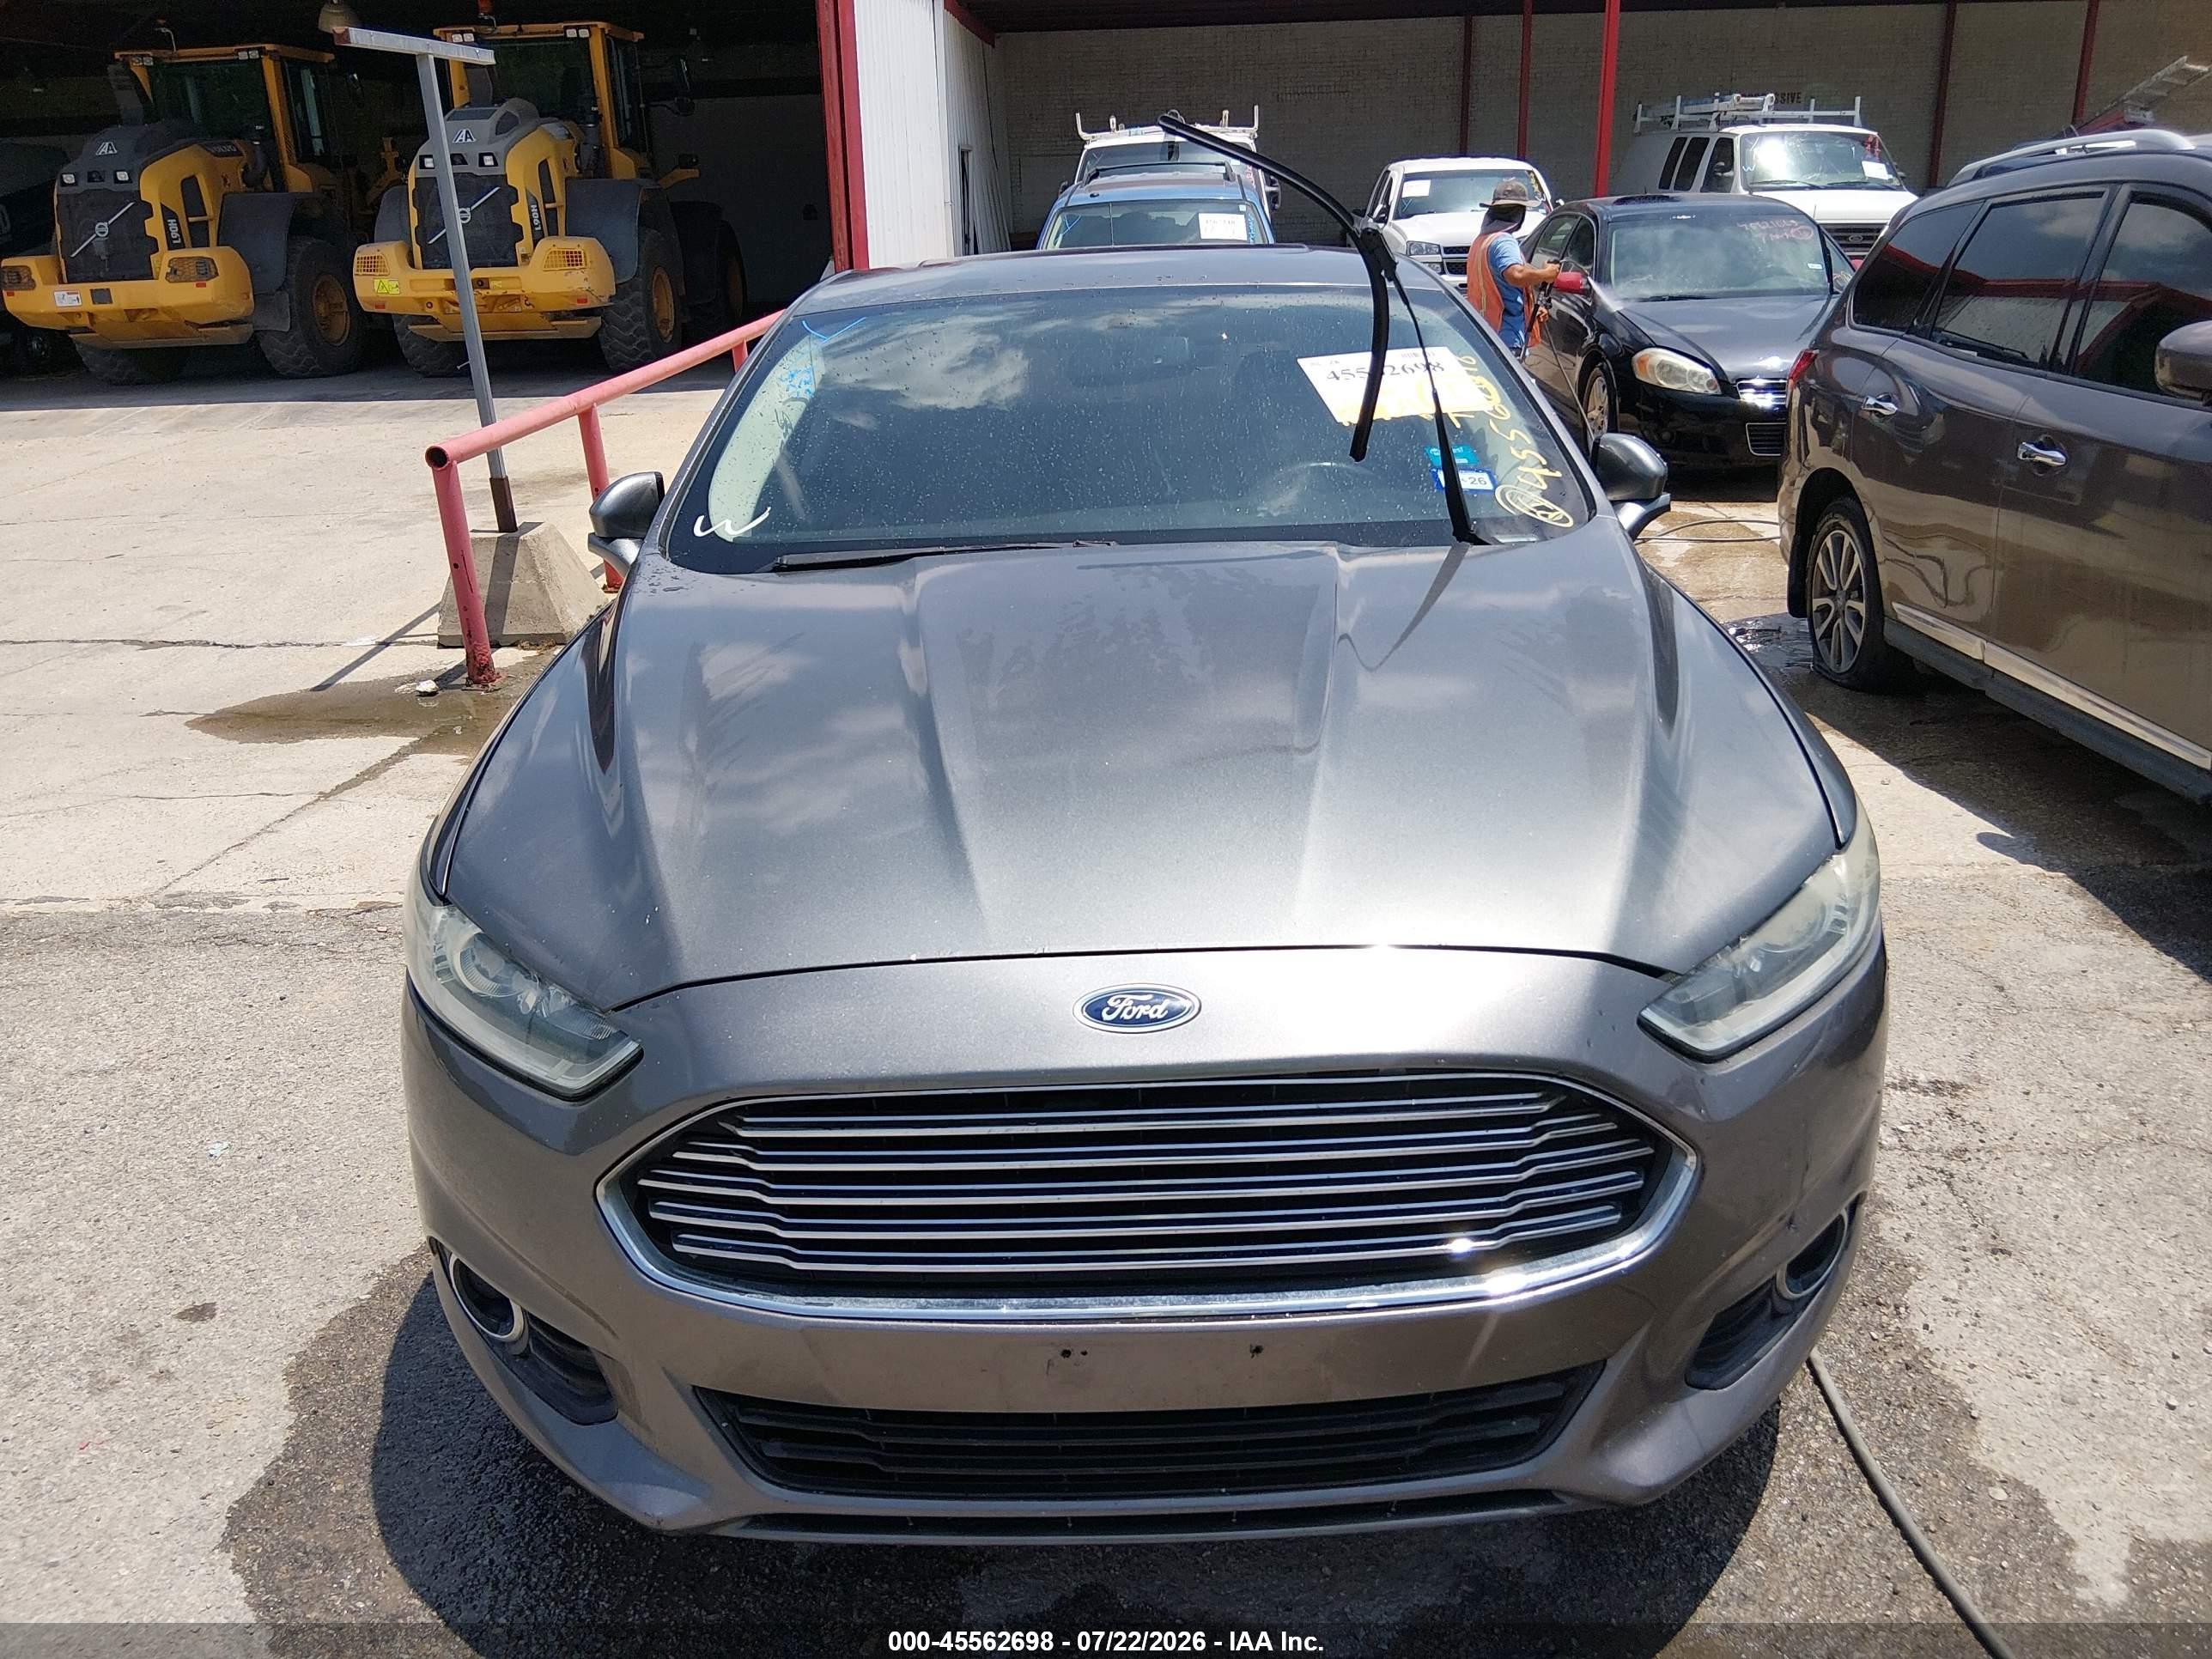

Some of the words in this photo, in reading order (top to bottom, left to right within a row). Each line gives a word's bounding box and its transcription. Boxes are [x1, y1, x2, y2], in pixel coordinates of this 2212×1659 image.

[531, 204, 542, 231] L90H
[167, 219, 182, 244] L90H
[1327, 361, 1446, 381] 4552698
[1468, 476, 1487, 486] 26
[1101, 994, 1169, 1021] Ford
